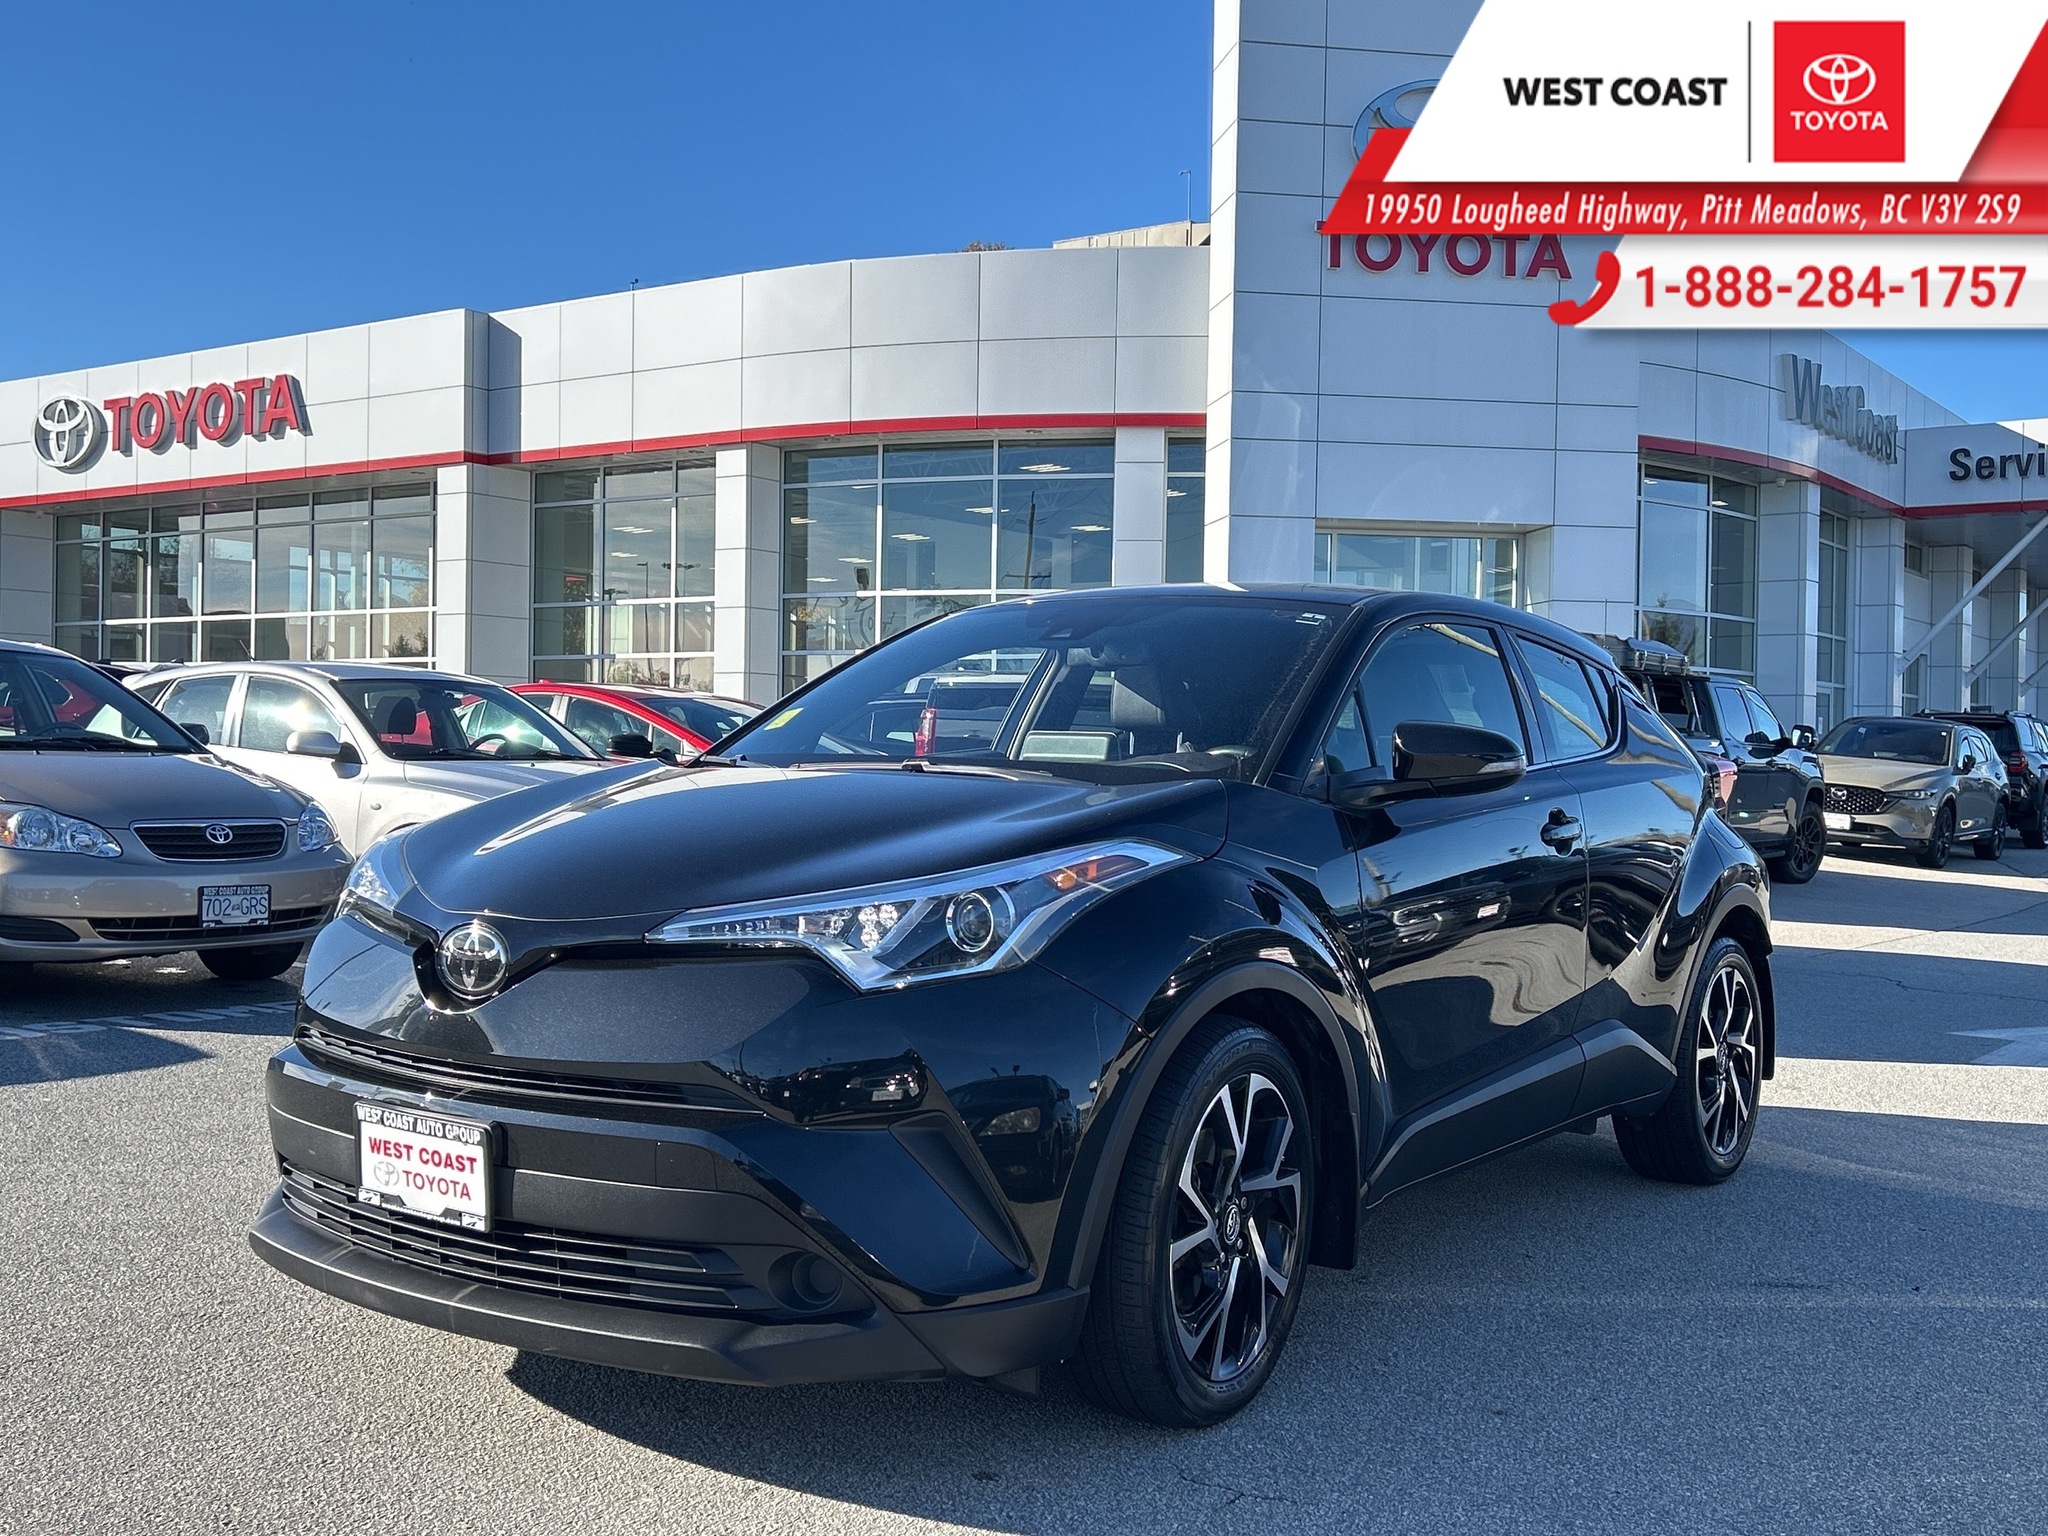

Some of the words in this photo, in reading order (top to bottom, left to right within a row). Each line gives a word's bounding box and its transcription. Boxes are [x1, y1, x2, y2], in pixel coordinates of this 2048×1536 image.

[1317, 221, 1573, 281] TOYOTA
[103, 373, 302, 452] TOYOTA
[1949, 443, 2047, 481] Servi
[203, 898, 232, 917] 702
[240, 897, 268, 916] GRS
[219, 886, 237, 895] COAST
[356, 1105, 382, 1124] WEST
[383, 1112, 415, 1131] COAST
[416, 1120, 444, 1137] AUTO
[445, 1125, 481, 1145] GROUP
[368, 1136, 413, 1161] WEST
[419, 1147, 477, 1174] COAST
[402, 1170, 472, 1201] TOYOTA
